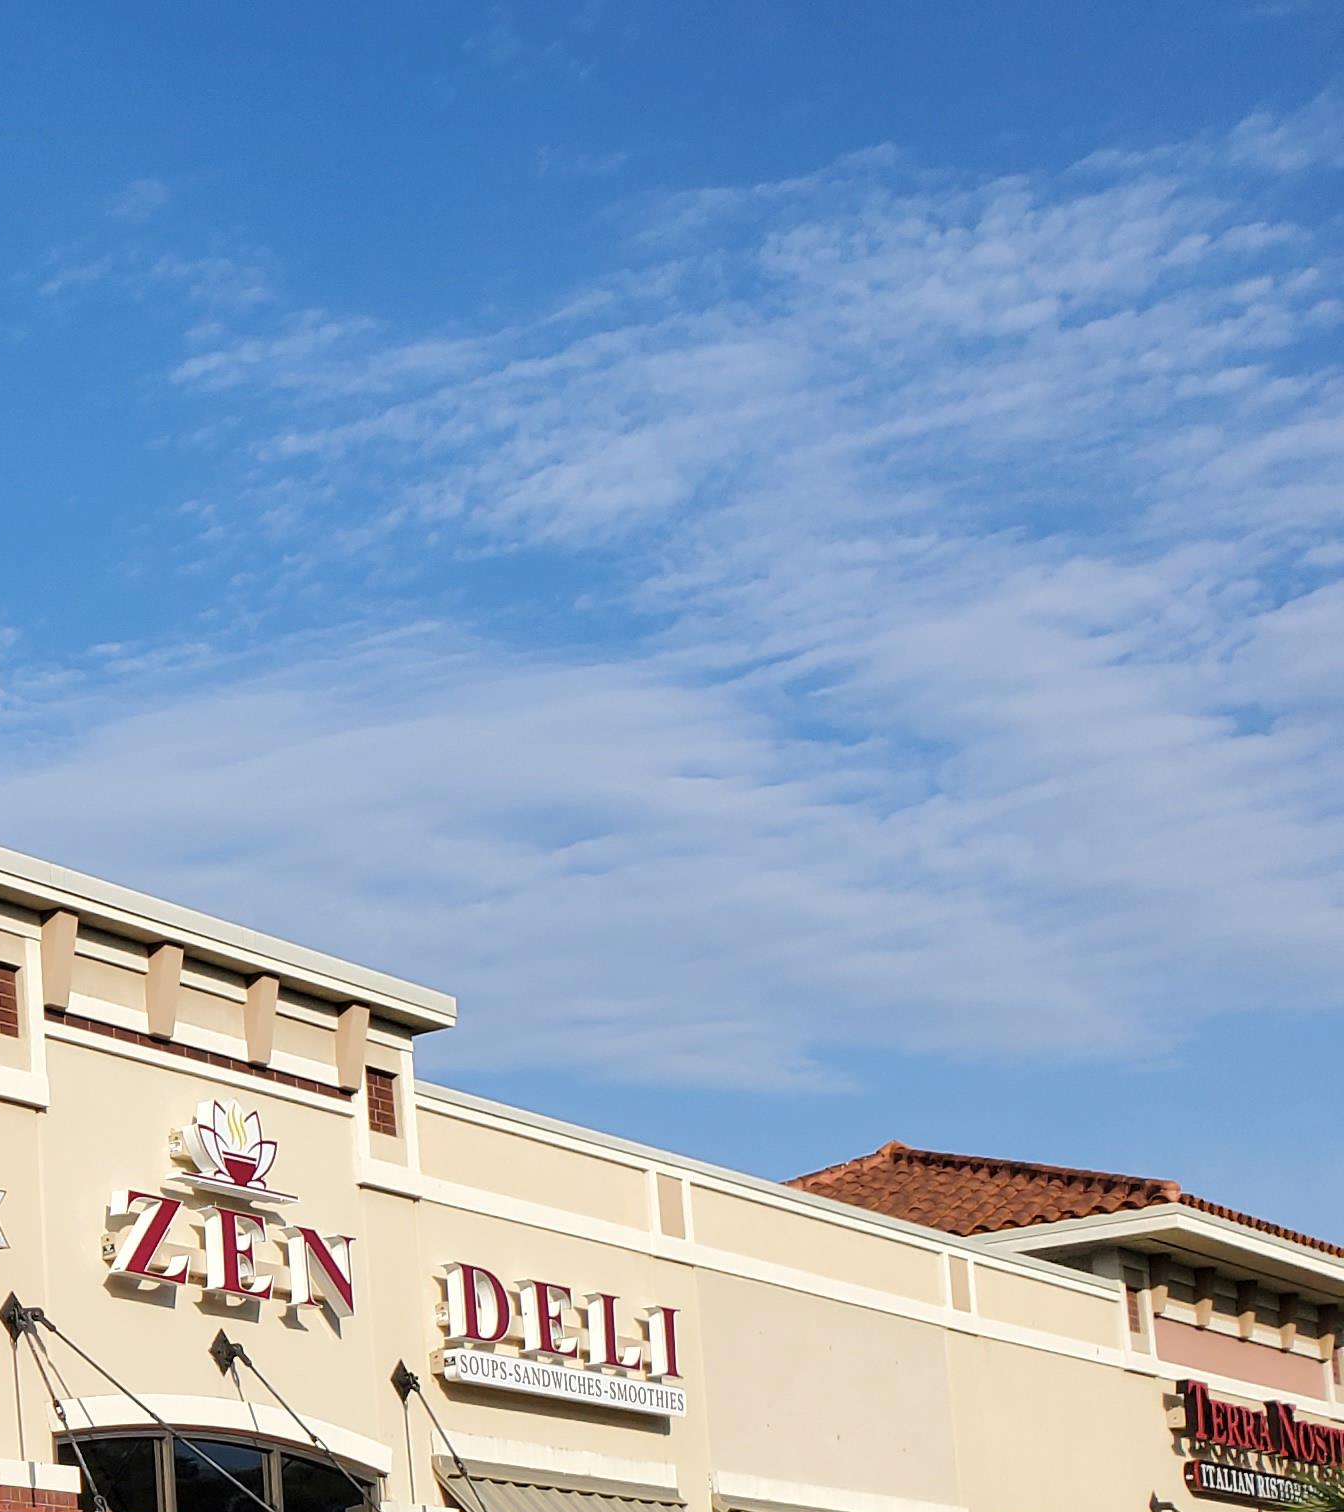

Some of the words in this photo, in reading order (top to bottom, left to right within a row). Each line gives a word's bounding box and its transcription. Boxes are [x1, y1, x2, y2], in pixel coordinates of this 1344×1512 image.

[108, 1189, 356, 1316] ZEN
[442, 1261, 684, 1379] DELI
[1200, 1463, 1255, 1497] ITALIAN
[1271, 1401, 1344, 1467] NOST
